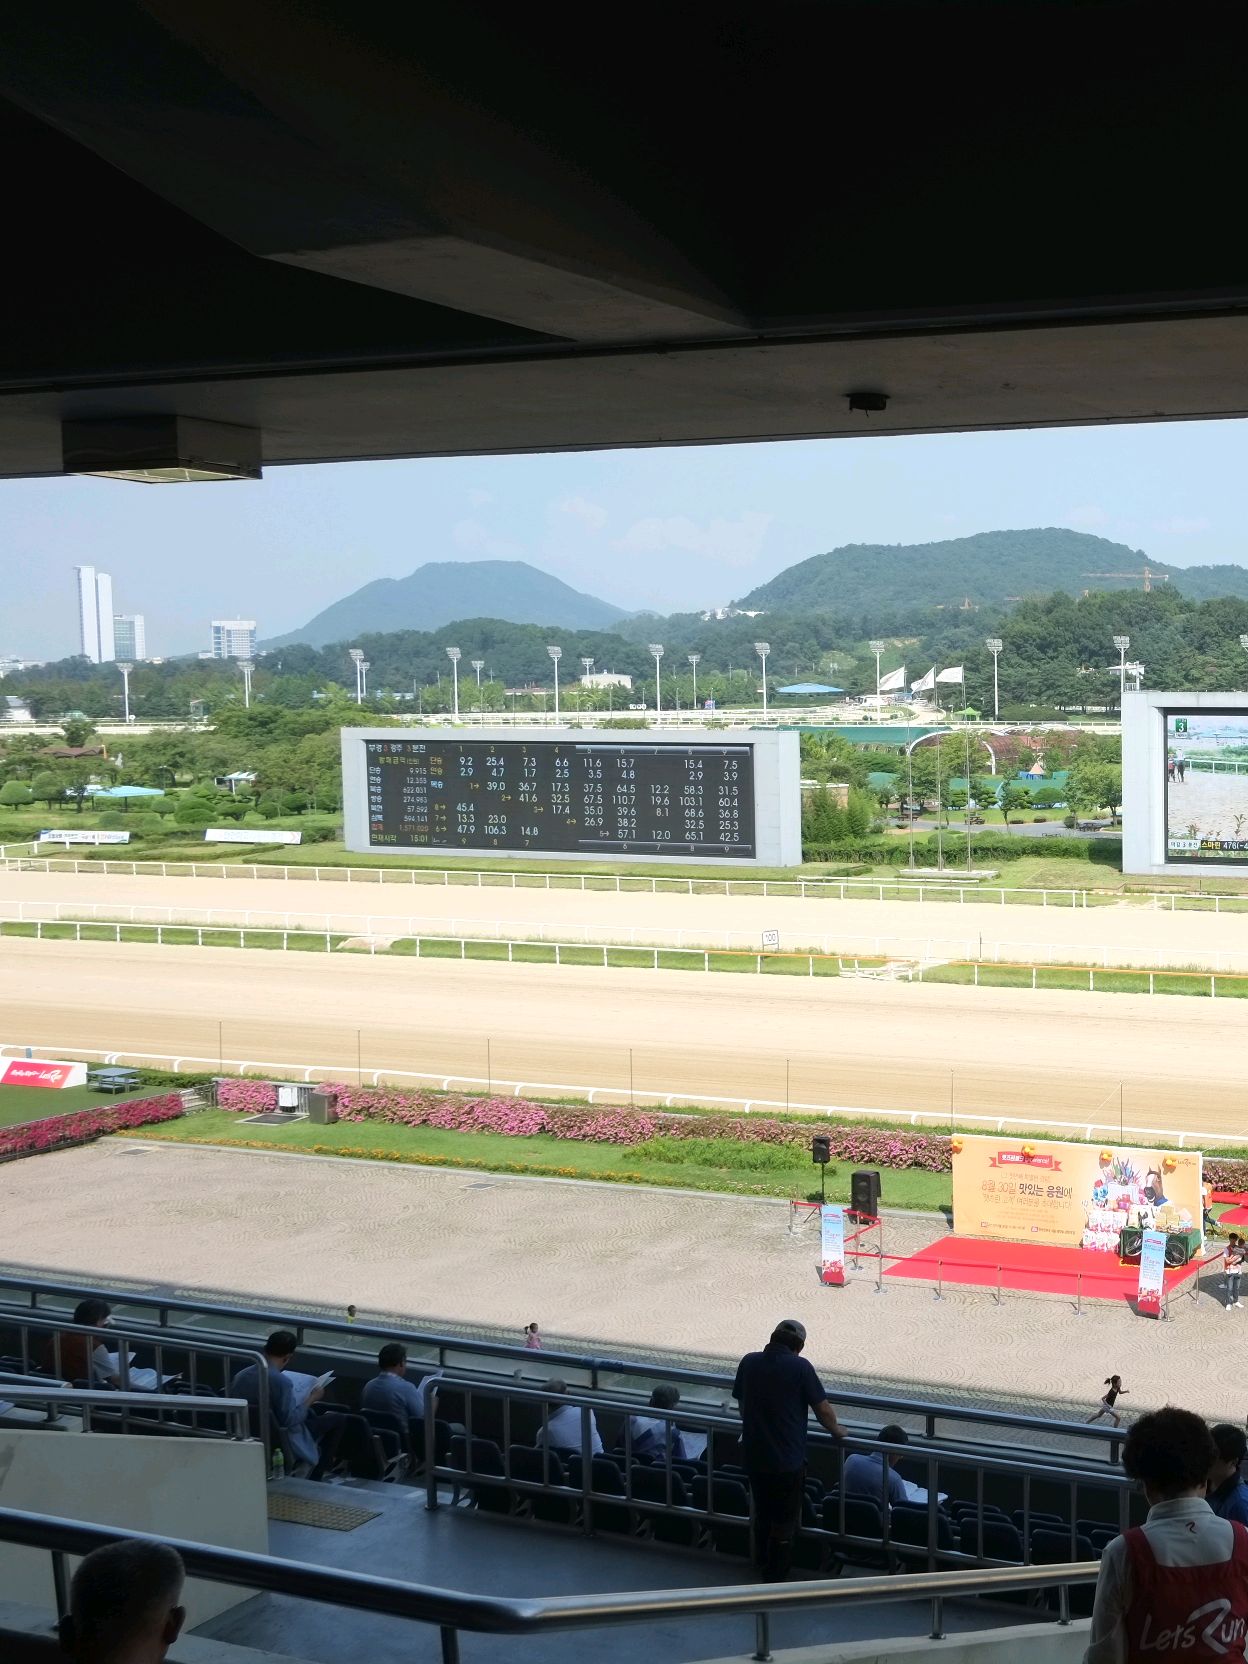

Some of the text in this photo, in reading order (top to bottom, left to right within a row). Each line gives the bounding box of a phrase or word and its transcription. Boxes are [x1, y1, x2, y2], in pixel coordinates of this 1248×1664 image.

[1179, 722, 1184, 732] 3
[460, 757, 473, 766] 9.2
[486, 757, 504, 766] 25.4
[523, 758, 536, 766] 7.3
[556, 758, 569, 766] 6.6
[584, 759, 602, 767] 11.6
[617, 759, 635, 767] 15.7
[685, 760, 702, 768] 15.4
[724, 761, 738, 769] 7.5
[460, 768, 473, 776] 2.9
[492, 768, 504, 776] 4.7
[524, 769, 536, 777] 1.7
[556, 769, 569, 777] 2.5
[589, 770, 602, 778] 3.5
[621, 770, 635, 779] 4.8
[690, 772, 703, 780] 2.9
[724, 772, 738, 780] 3.9
[487, 782, 505, 790] 39.0
[519, 783, 536, 791] 36.7
[552, 783, 569, 792] 17.3
[584, 784, 602, 792] 37.5
[617, 785, 635, 793] 64.5
[651, 785, 669, 794] 12.2
[684, 786, 703, 794] 58.3
[719, 786, 739, 795] 31.5
[519, 794, 538, 802] 41.6
[552, 794, 570, 803] 32.5
[584, 795, 603, 804] 67.5
[612, 796, 635, 804] 110.7
[651, 796, 670, 805] 19.6
[680, 797, 702, 806] 103.1
[719, 798, 738, 807] 60.4
[456, 803, 739, 818] 45.4 17.4 35.0 39.6 8.1 68.6 36.8
[457, 814, 474, 823] 13.3
[489, 815, 506, 823] 23.0
[585, 818, 603, 826] 26.9
[618, 818, 637, 827] 38.2
[685, 820, 704, 829] 32.5
[720, 821, 739, 830] 25.3
[457, 825, 475, 834] 47.9
[484, 826, 506, 835] 106.3
[521, 826, 538, 835] 14.8
[618, 830, 636, 839] 57.1
[652, 831, 671, 840] 12.0
[685, 832, 703, 840] 65.1
[720, 833, 739, 842] 42.5
[1019, 1184, 1044, 1196] 맛있는
